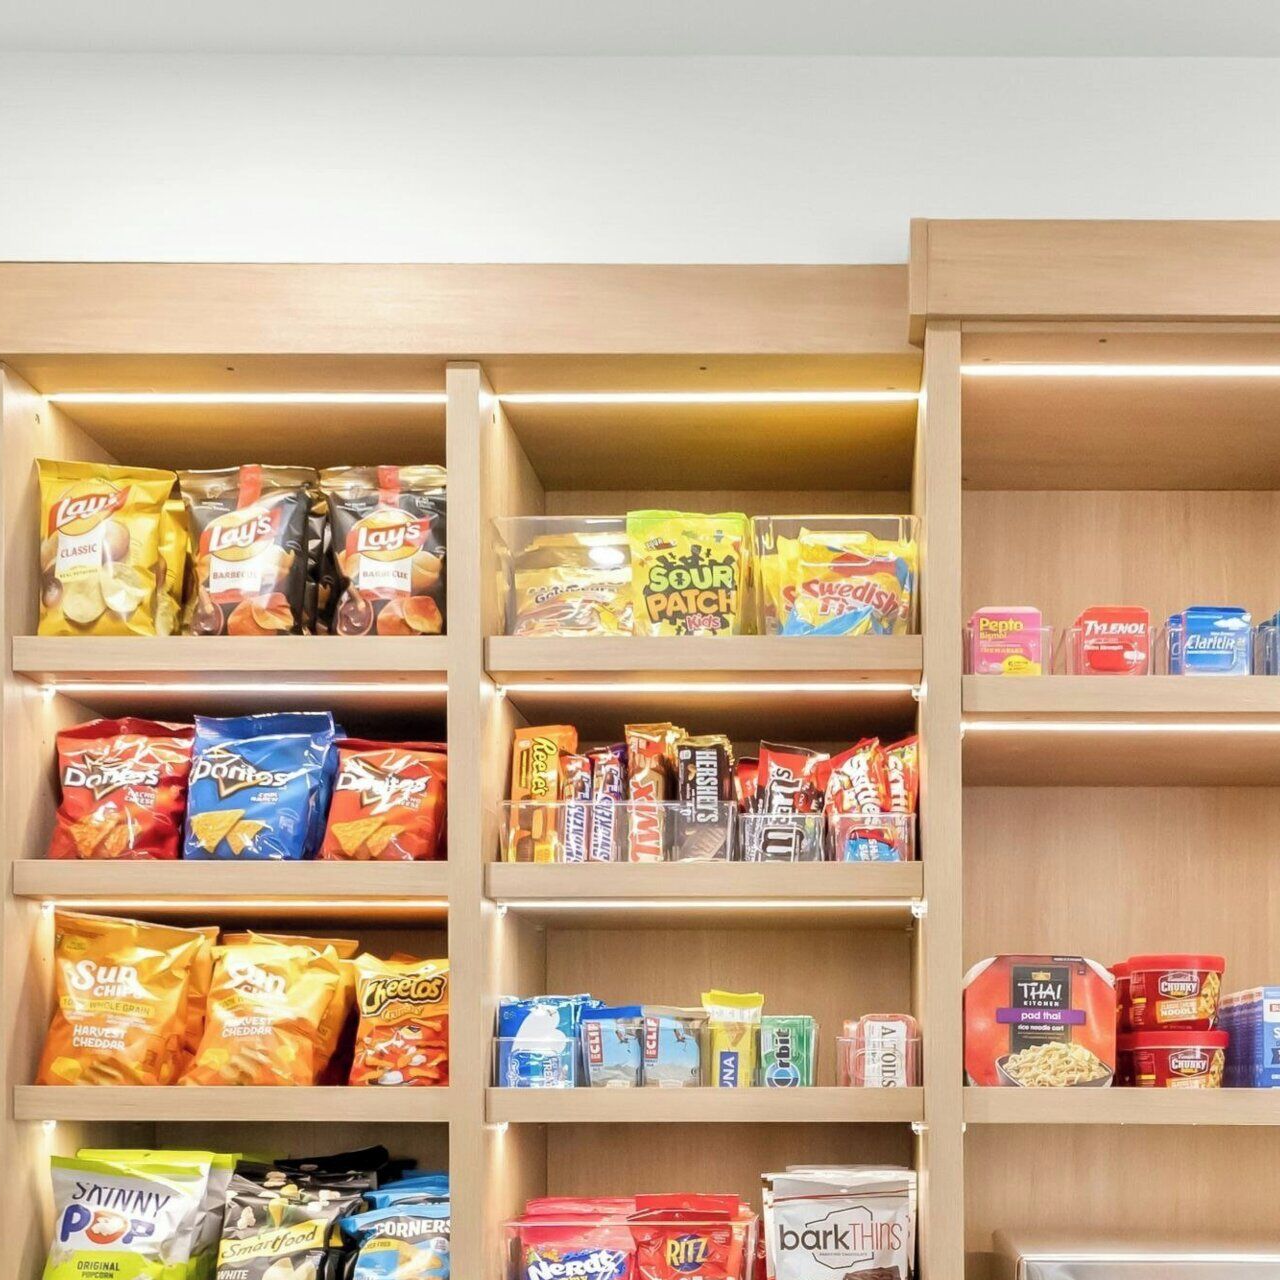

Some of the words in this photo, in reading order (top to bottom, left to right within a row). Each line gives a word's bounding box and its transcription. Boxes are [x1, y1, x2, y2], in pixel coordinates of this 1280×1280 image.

[209, 514, 272, 552] Lay's
[357, 522, 421, 551] Lay's
[60, 543, 97, 558] CLASSIC
[650, 565, 735, 592] SOUR
[646, 589, 736, 621] PATCH
[802, 579, 900, 616] Swedish
[819, 596, 857, 616] Fi
[686, 614, 721, 630] Kids
[979, 617, 1024, 632] Pepto
[1084, 620, 1146, 637] TYLENOL
[1186, 635, 1236, 651] Claritin
[192, 760, 289, 787] Doritos
[696, 747, 719, 824] HERSHEY'S
[630, 780, 663, 863] TWIX
[363, 976, 446, 1016] Cheetos
[1018, 982, 1063, 1001] THAI
[1161, 981, 1198, 993] CHUNKY
[1021, 1011, 1041, 1021] pad
[1043, 1011, 1061, 1020] thai
[73, 1025, 127, 1039] HARVEST
[222, 1026, 273, 1037] CHEDDAR
[73, 1037, 125, 1050] CHEDDAR
[1171, 1060, 1207, 1070] CHUNKY
[72, 1182, 170, 1217] SKINNY
[60, 1203, 156, 1244] POP
[221, 1226, 318, 1260] Smartfood
[667, 1237, 709, 1267] RITZ
[77, 1260, 120, 1272] ORIGINAL
[81, 1271, 114, 1279] POPCORN
[217, 1269, 249, 1280] WHITE
